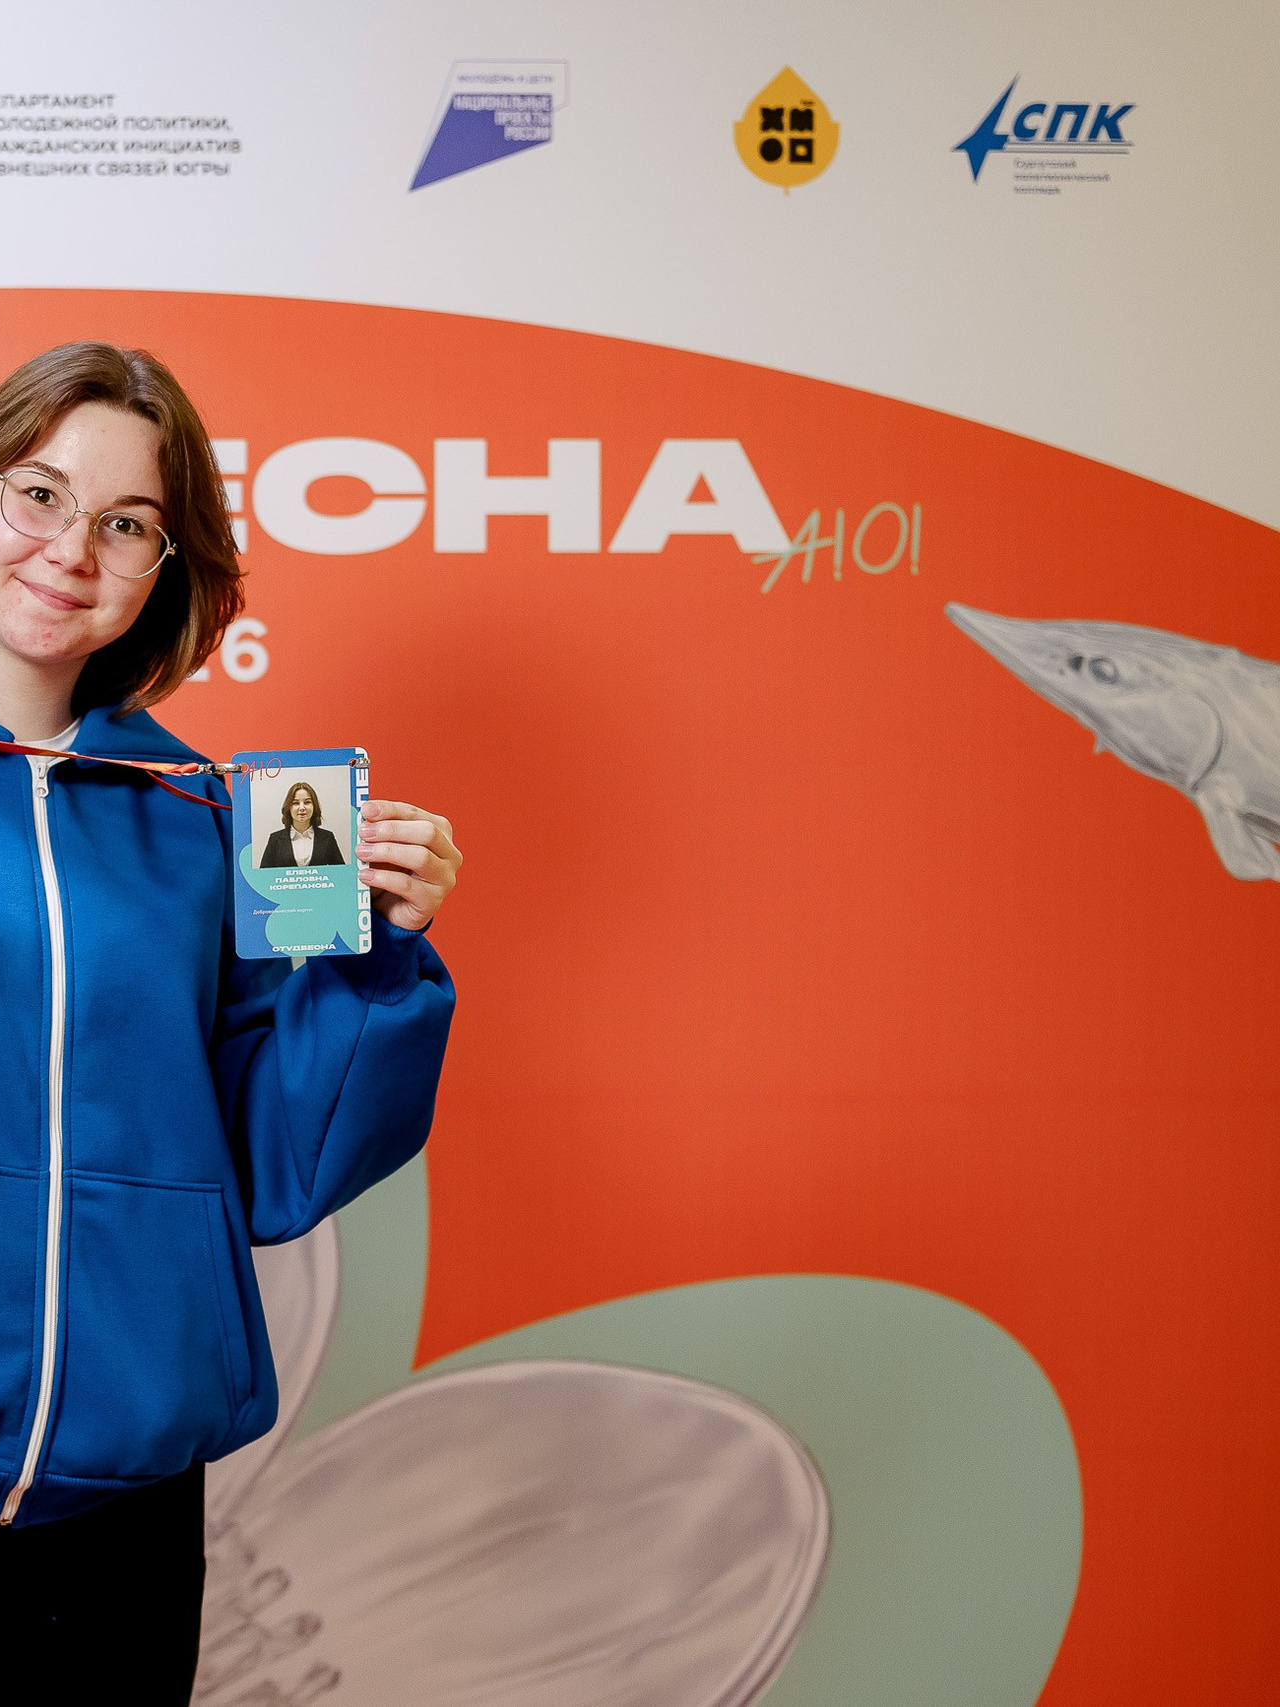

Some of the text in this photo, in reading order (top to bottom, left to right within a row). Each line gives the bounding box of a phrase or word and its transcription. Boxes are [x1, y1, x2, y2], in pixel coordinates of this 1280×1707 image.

[122, 116, 233, 131] ПОЛИТИКИ,
[1013, 103, 1136, 142] СПК
[122, 139, 242, 154] ИНИЦИАТИВ
[95, 159, 168, 176] СВЯЗЕЙ
[173, 162, 231, 176] ЮГРЫ
[275, 875, 329, 883] ПАВЛОВНА
[269, 883, 335, 891] КОРЕПАНОВА
